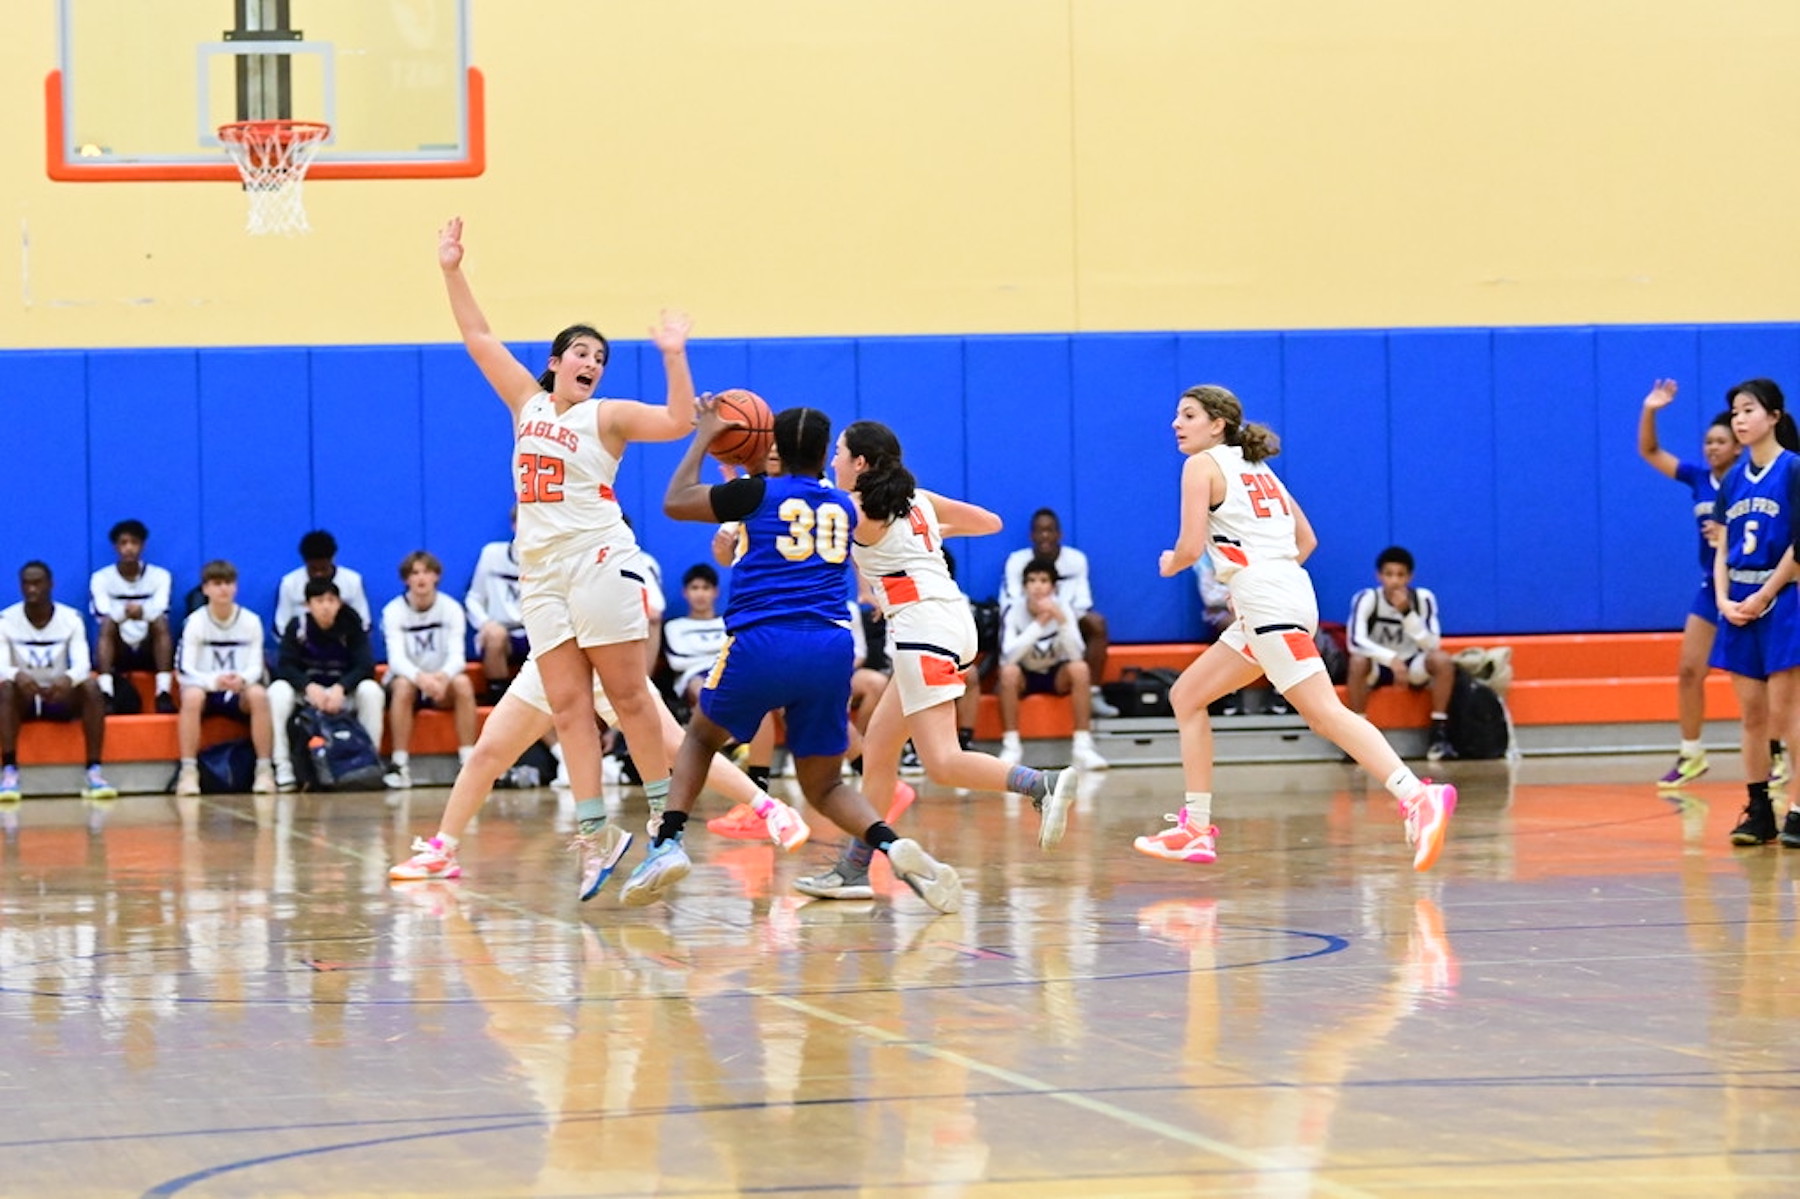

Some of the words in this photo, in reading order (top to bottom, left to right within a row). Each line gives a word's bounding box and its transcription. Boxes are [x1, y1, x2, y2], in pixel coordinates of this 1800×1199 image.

[519, 453, 565, 503] 32
[1240, 473, 1289, 518] 24
[775, 498, 850, 564] 30
[908, 504, 933, 552] 4
[1743, 521, 1759, 555] 5
[415, 631, 436, 656] M
[1379, 626, 1403, 645] M
[212, 650, 236, 671] M
